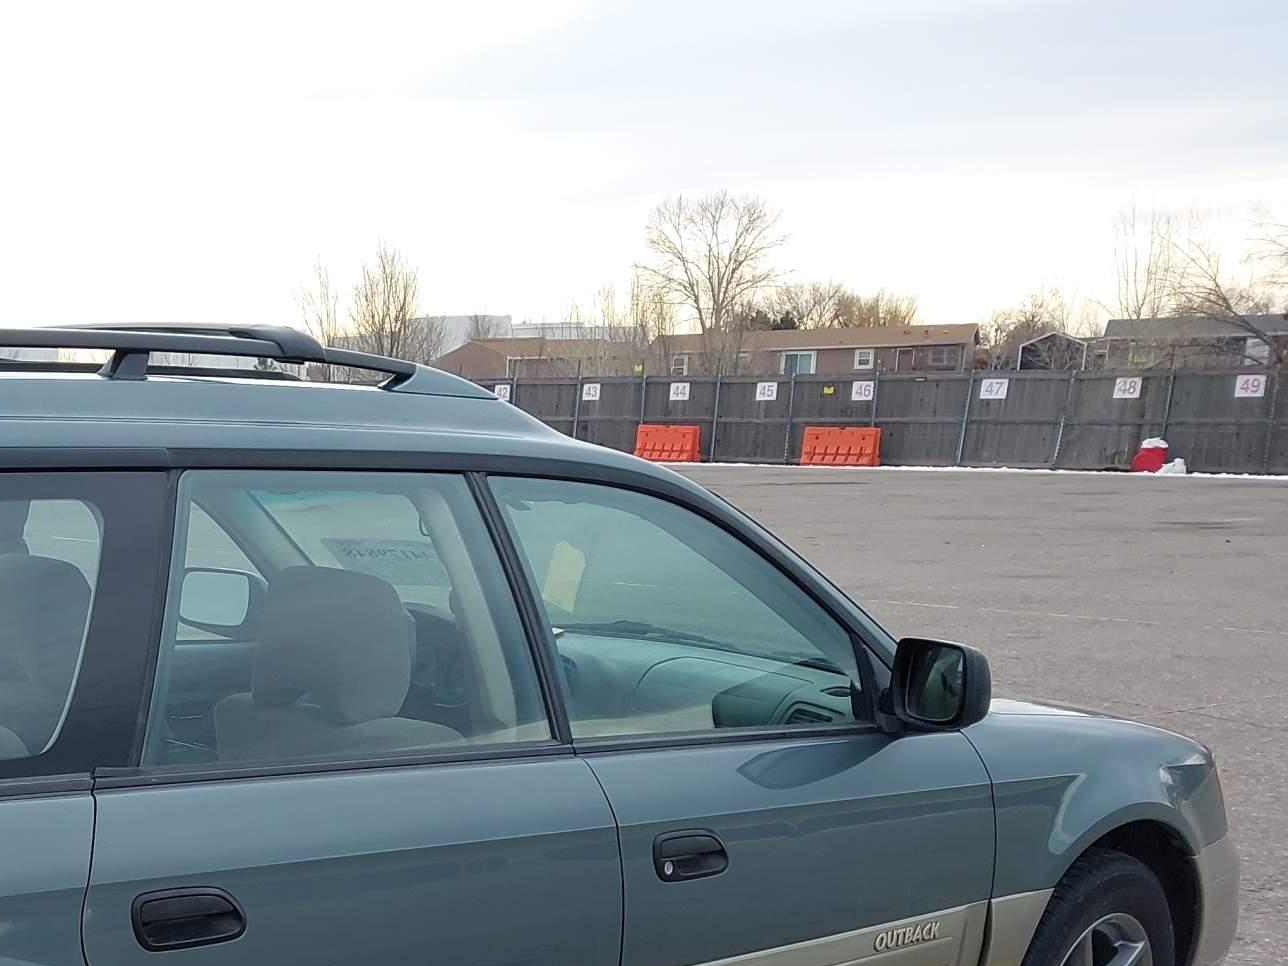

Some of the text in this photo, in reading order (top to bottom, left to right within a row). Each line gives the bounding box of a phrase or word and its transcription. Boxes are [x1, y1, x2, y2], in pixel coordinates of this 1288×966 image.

[496, 386, 509, 398] 42
[585, 385, 598, 398] 43
[672, 385, 688, 398] 44
[759, 384, 774, 398] 45
[855, 384, 873, 398] 46
[985, 382, 1004, 396] 47
[1118, 380, 1137, 395] 48
[1240, 378, 1261, 393] 49
[874, 921, 940, 952] OUTBACK
